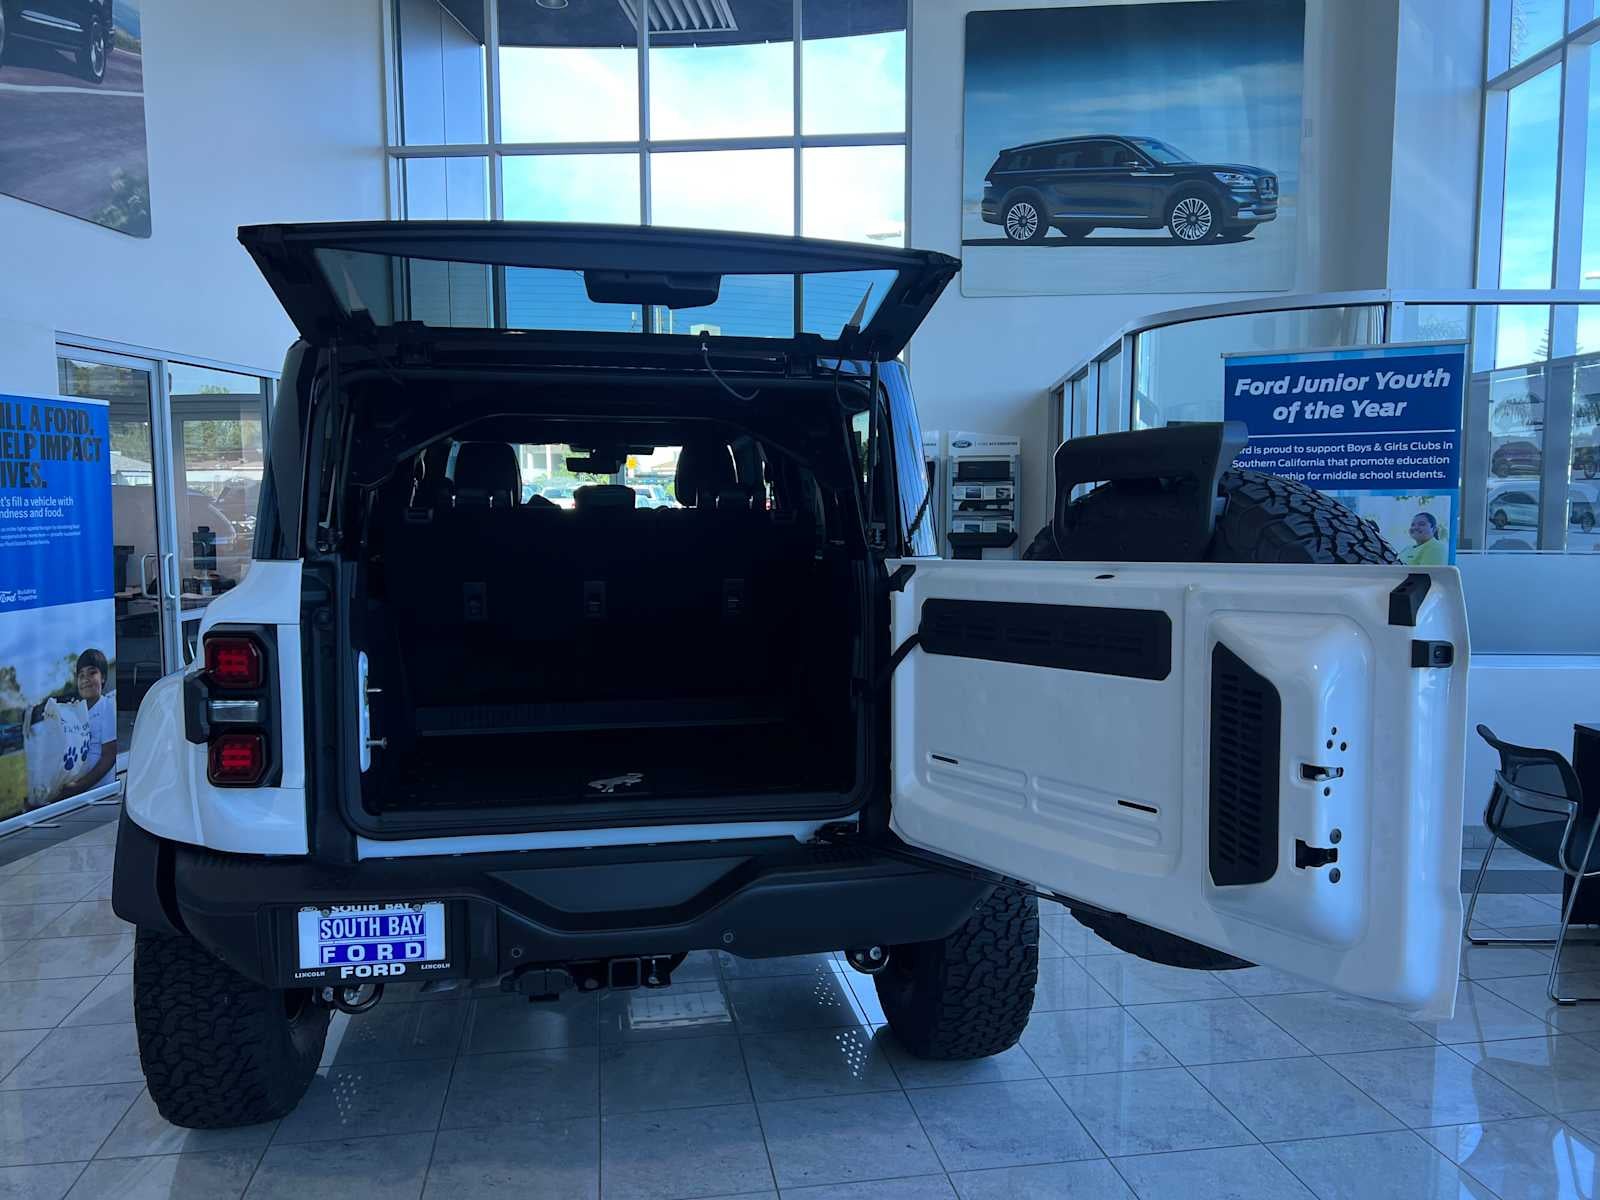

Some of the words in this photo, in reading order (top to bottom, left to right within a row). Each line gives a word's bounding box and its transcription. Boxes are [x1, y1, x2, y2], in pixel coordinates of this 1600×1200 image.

[1234, 375, 1291, 396] Ford
[1291, 373, 1370, 394] Junior
[1375, 367, 1451, 390] Youth
[0, 401, 26, 431] ILL
[30, 404, 42, 432] A
[44, 406, 95, 435] FORD.
[1272, 401, 1301, 424] of
[1304, 401, 1344, 420] the
[1351, 399, 1408, 418] Year
[40, 433, 102, 464] IMPACT
[1254, 446, 1262, 454] is
[1263, 445, 1292, 455] proud
[1294, 445, 1304, 454] to
[1305, 444, 1345, 454] support
[1347, 443, 1372, 453] Boys
[1374, 442, 1382, 452] &
[1384, 442, 1409, 451] Girls
[1410, 441, 1441, 451] Clubs
[1443, 441, 1453, 450] in
[1231, 459, 1277, 469] Southern
[1278, 458, 1325, 468] California
[1327, 457, 1348, 467] that
[1350, 456, 1395, 468] promote
[1396, 455, 1450, 465] education
[0, 461, 48, 489] IVES.
[1306, 471, 1321, 481] for
[1322, 471, 1358, 480] middle
[1359, 470, 1394, 480] school
[1395, 469, 1446, 479] students.
[0, 496, 10, 507] t's
[12, 496, 22, 507] fill
[24, 499, 29, 507] a
[30, 496, 57, 507] vehicle
[57, 496, 74, 506] with
[0, 508, 30, 519] ndness
[30, 507, 43, 518] and
[320, 917, 381, 940] SOUTH
[388, 913, 424, 937] BAY
[322, 941, 423, 963] FORD
[294, 970, 326, 979] LINCOLN
[340, 963, 406, 979] FORD
